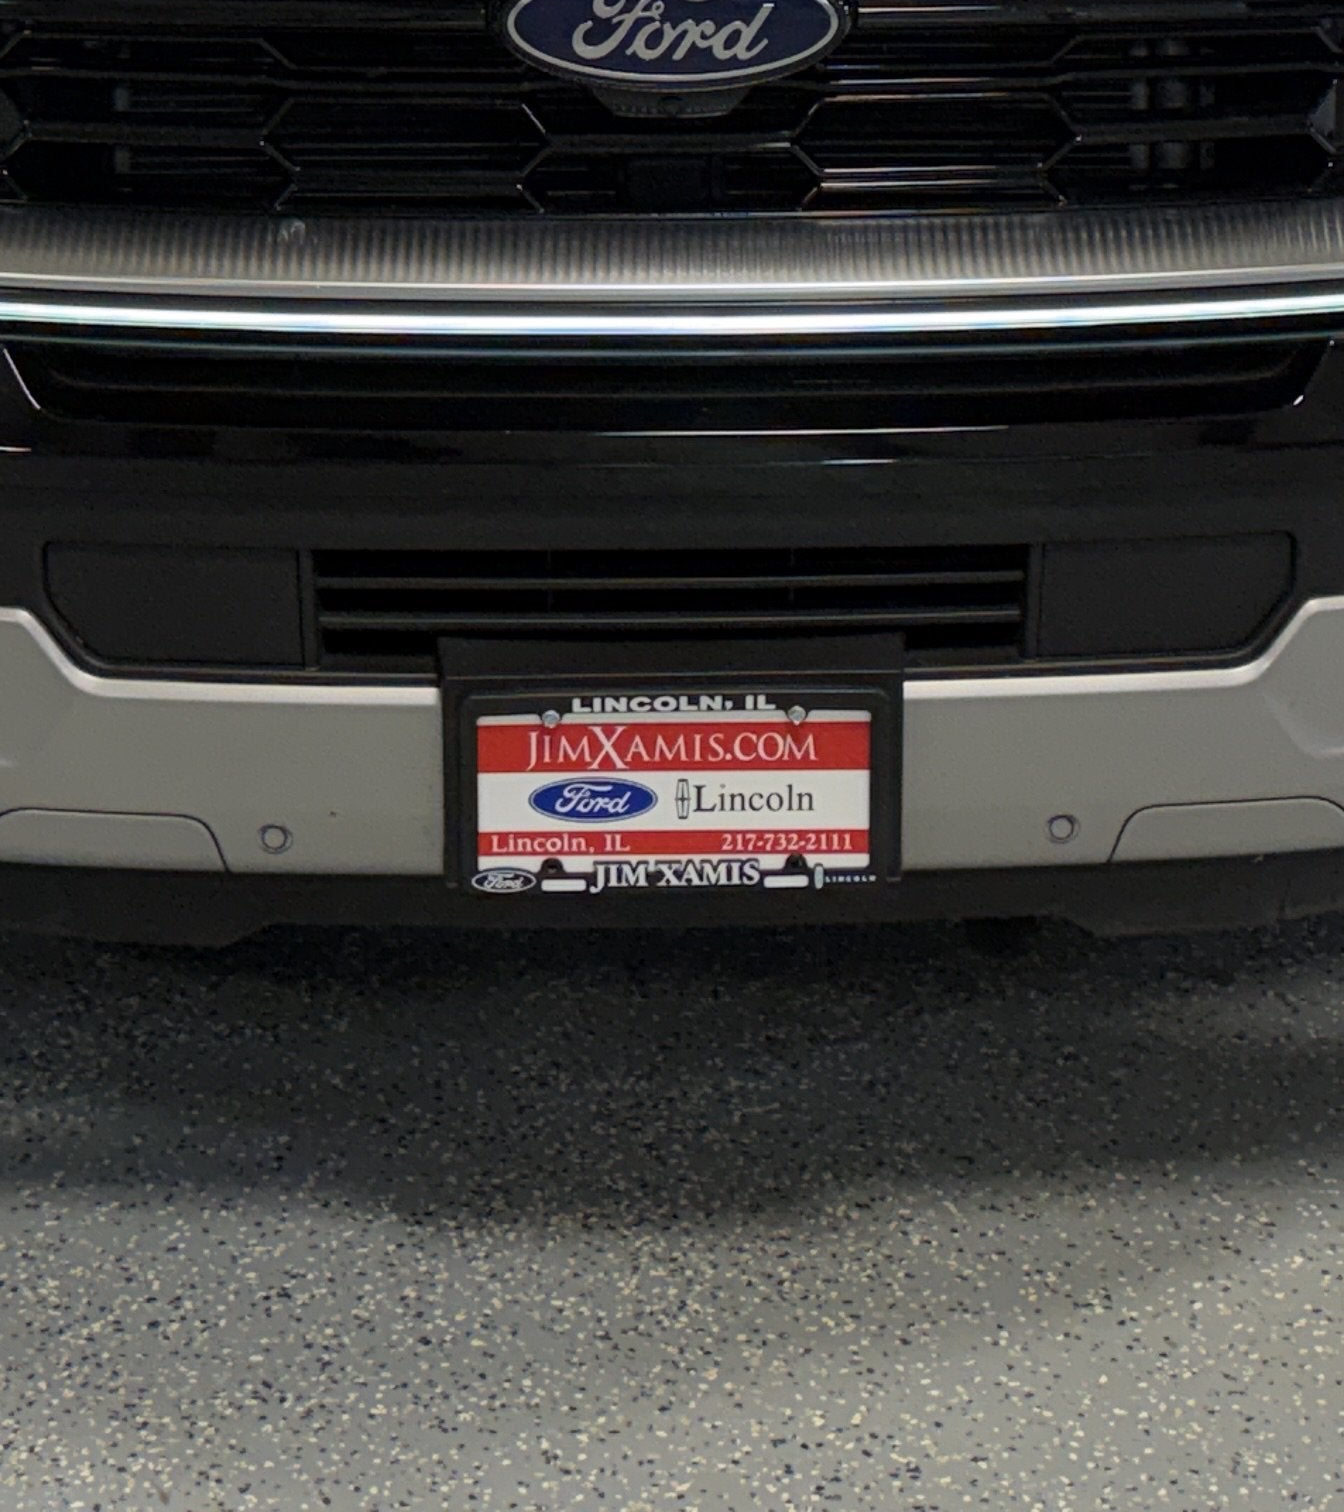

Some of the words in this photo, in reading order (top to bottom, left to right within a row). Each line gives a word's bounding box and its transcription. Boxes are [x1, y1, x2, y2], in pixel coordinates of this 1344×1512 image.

[571, 695, 734, 714] LINCOLN,
[745, 694, 777, 710] IL
[554, 783, 630, 814] Ford
[693, 784, 815, 813] Lincoln
[491, 834, 594, 854] Lincoln,
[604, 834, 631, 853] IL
[721, 833, 853, 852] 217-732-2111
[589, 863, 649, 894] JIM
[656, 861, 761, 888] XAMIS
